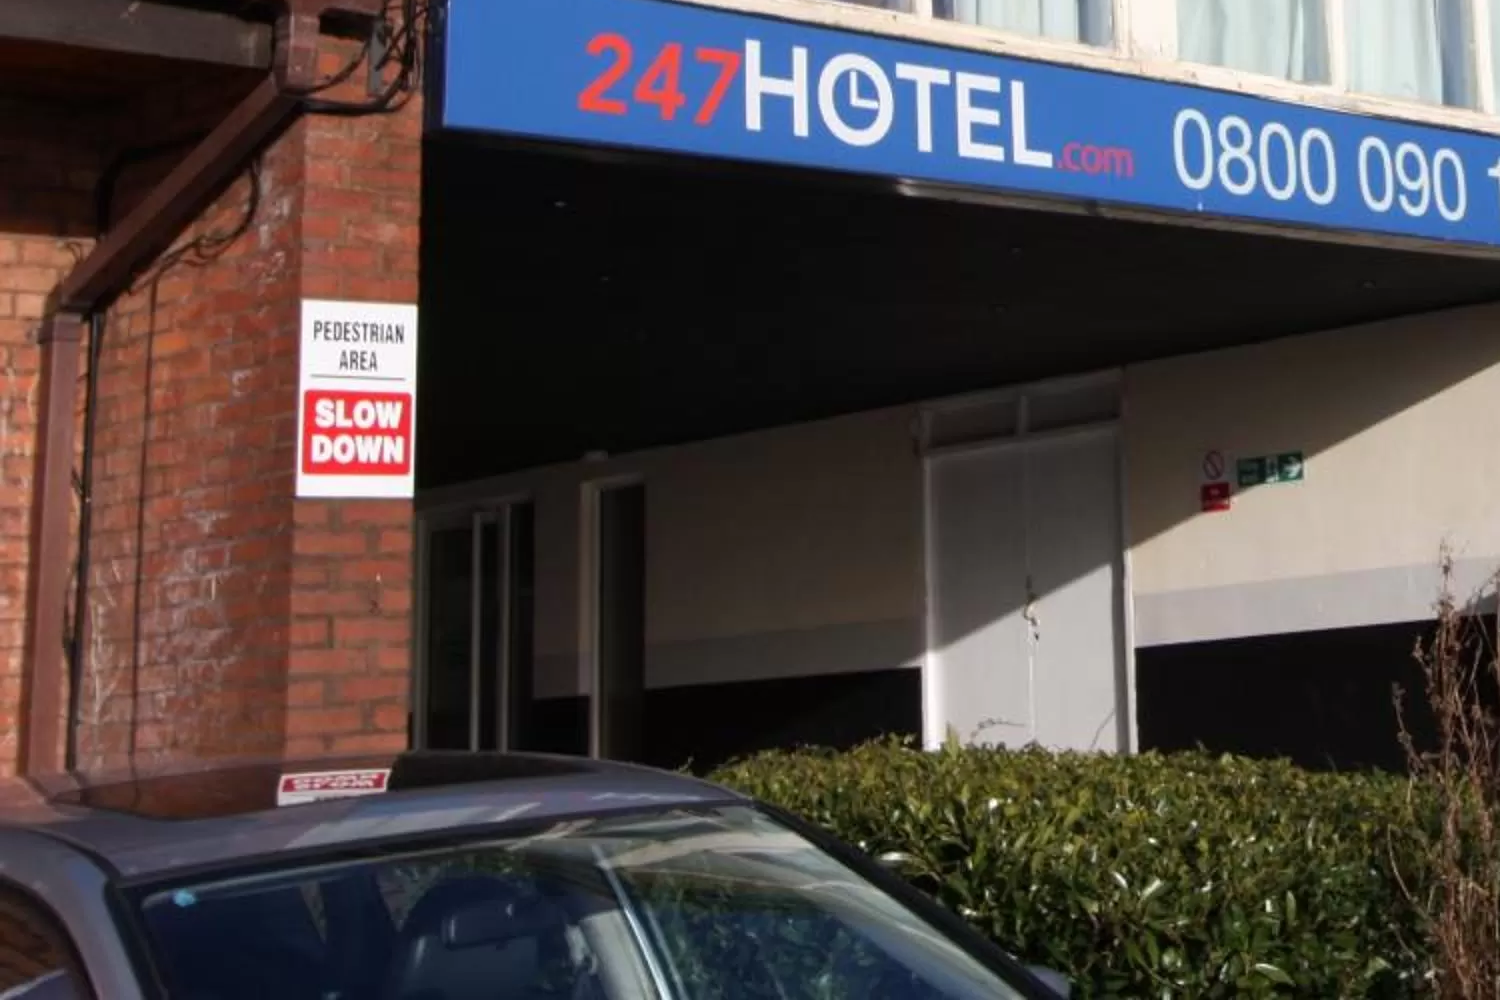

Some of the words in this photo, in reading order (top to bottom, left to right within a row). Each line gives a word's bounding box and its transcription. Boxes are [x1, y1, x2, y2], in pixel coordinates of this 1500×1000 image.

[1173, 108, 1337, 205] 0800
[1358, 136, 1467, 222] 090
[313, 320, 405, 345] PEDESTRIAN
[339, 350, 378, 372] AREA
[315, 398, 403, 429] SLOW
[311, 434, 404, 465] DOWN
